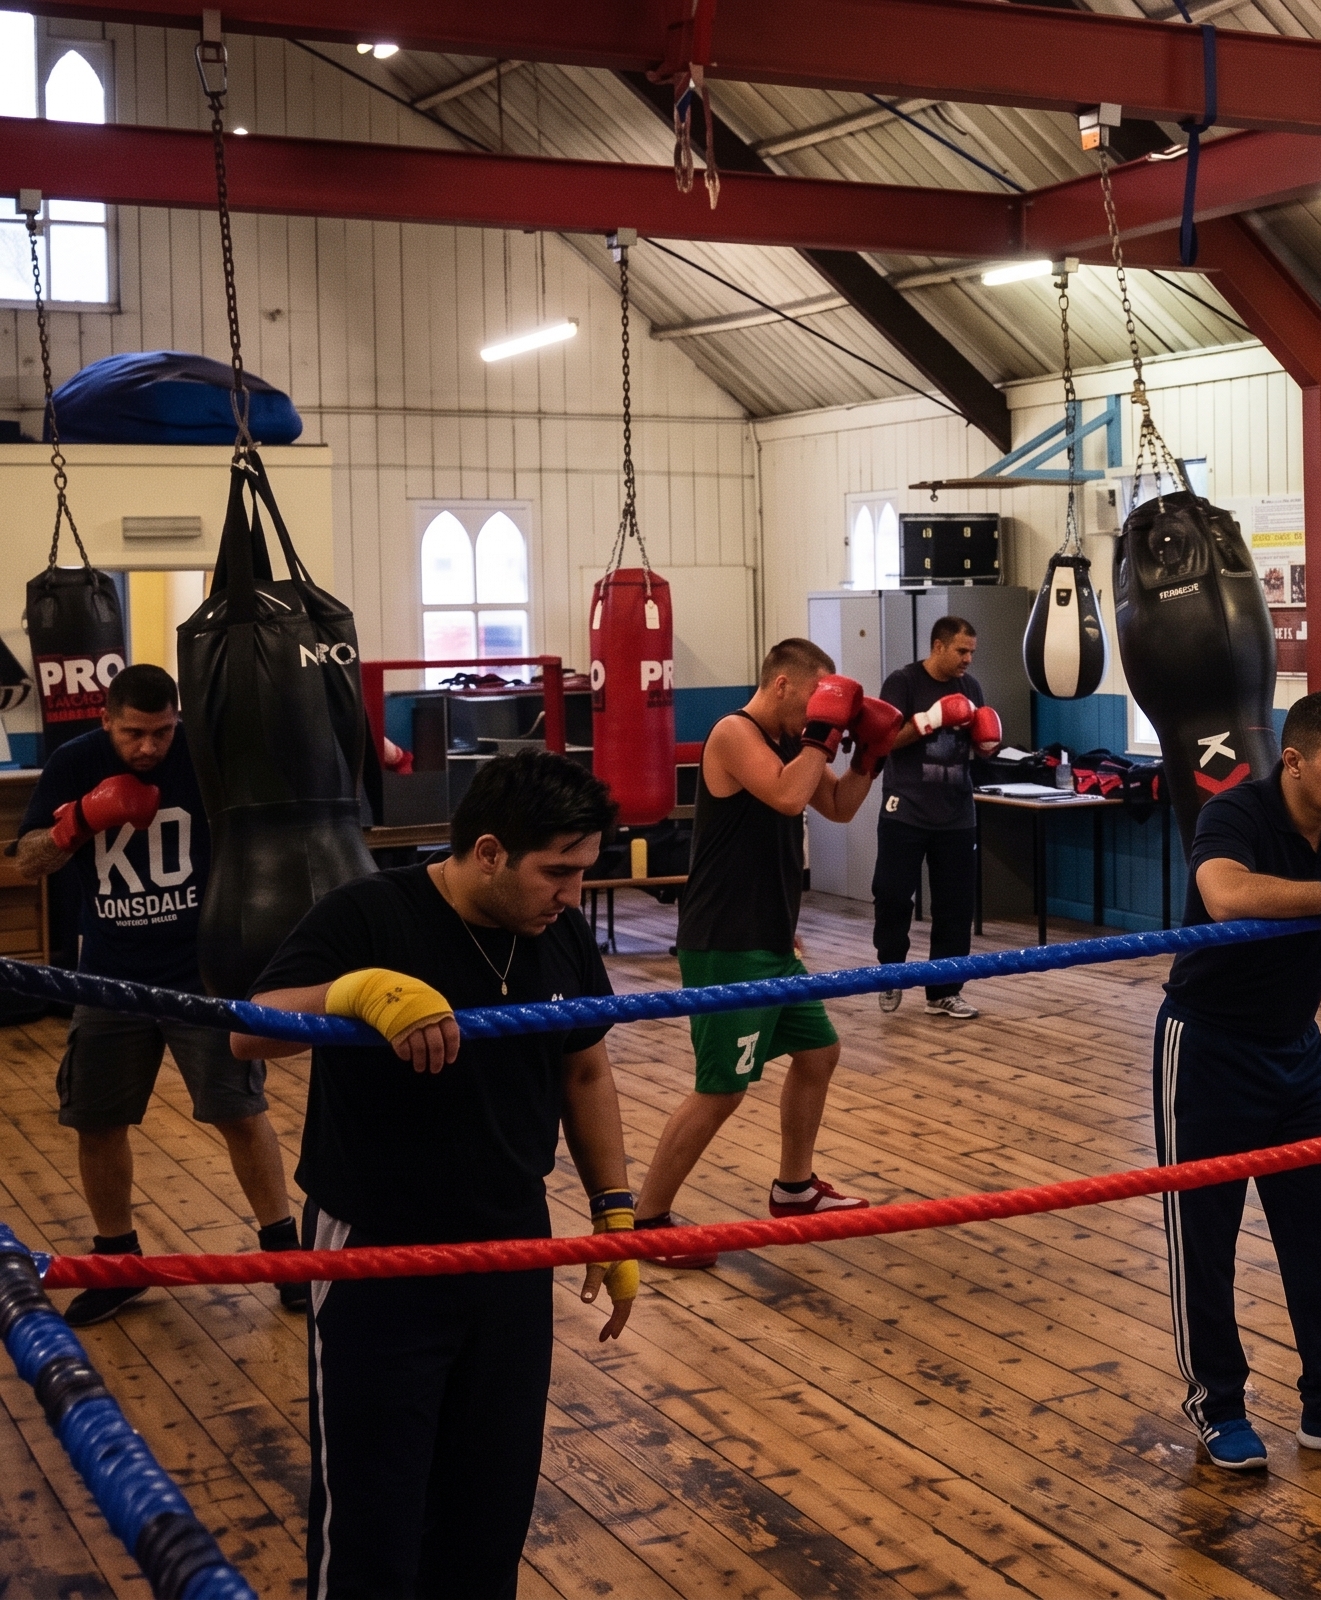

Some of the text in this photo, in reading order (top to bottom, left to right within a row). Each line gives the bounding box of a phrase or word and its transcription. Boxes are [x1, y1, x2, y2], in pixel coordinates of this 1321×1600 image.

[39, 653, 125, 697] PRO
[94, 806, 193, 895] KO
[95, 886, 199, 919] LONSDALE
